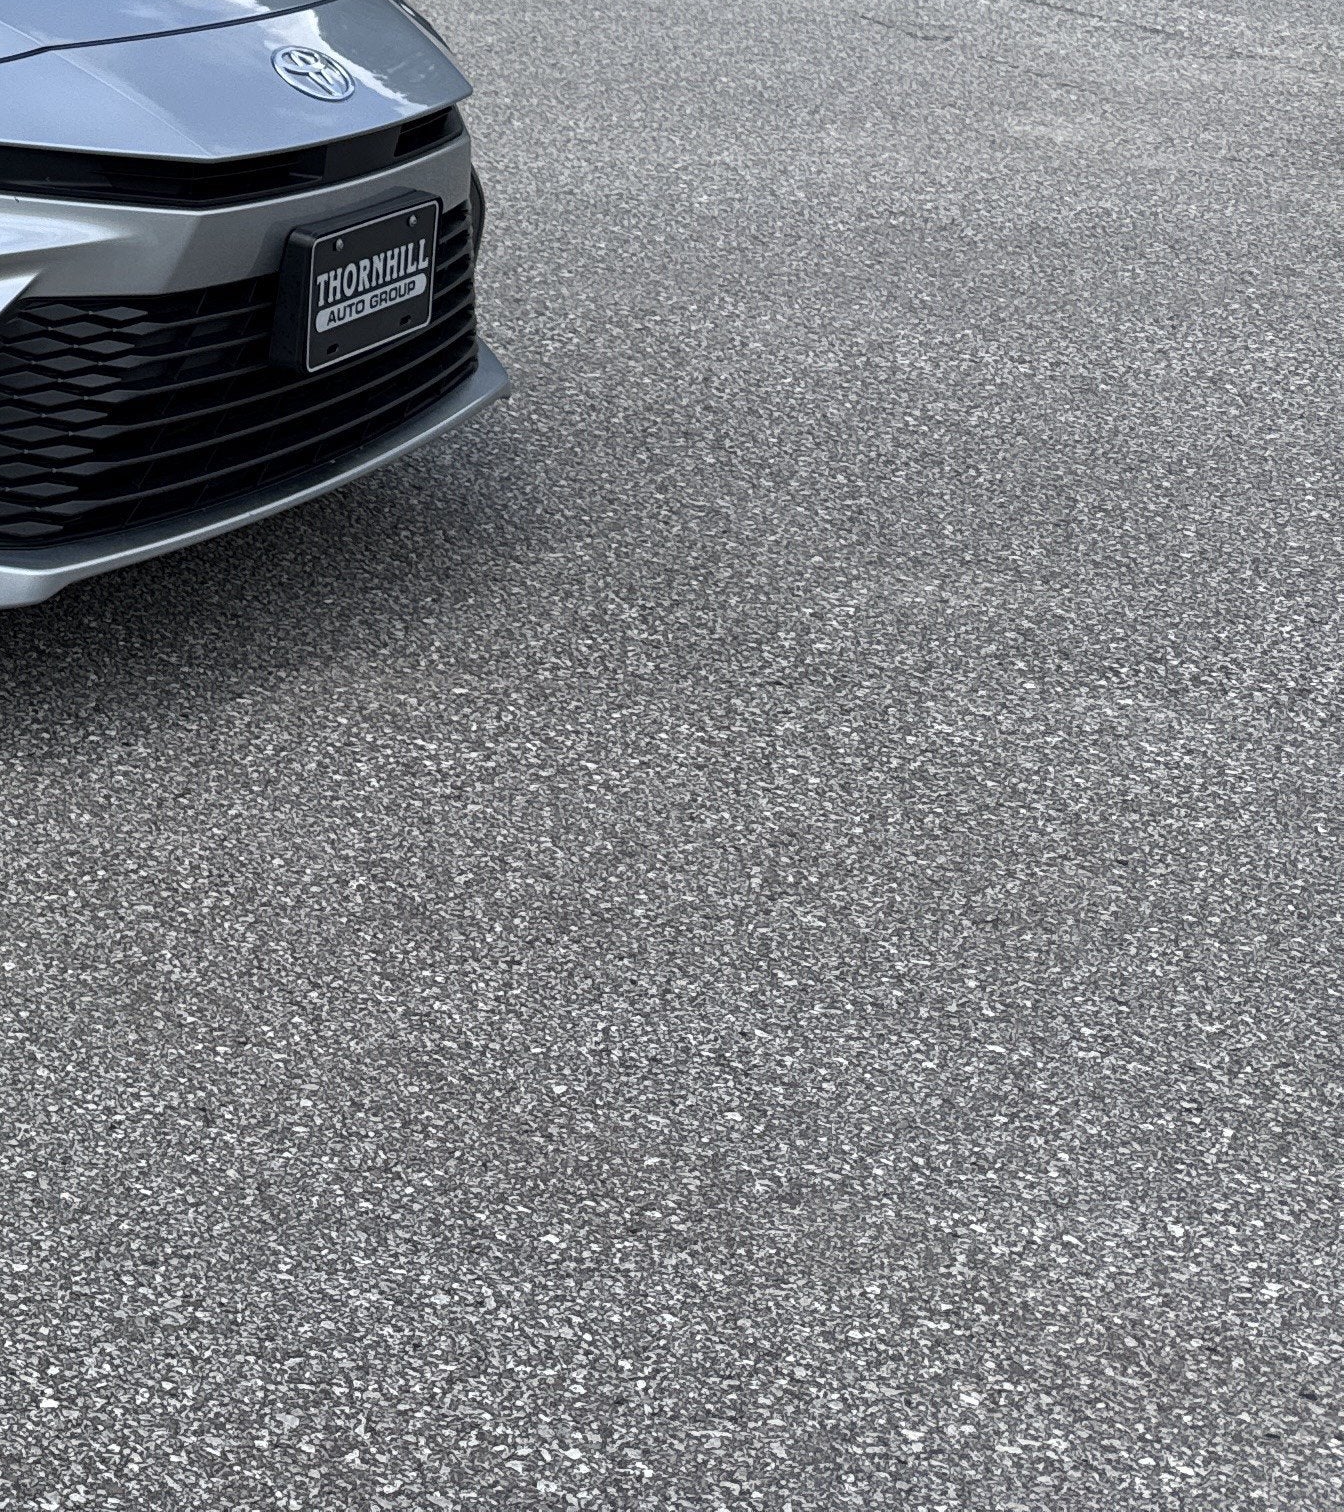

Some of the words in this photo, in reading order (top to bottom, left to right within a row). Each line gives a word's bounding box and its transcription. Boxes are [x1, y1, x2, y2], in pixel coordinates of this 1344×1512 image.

[316, 238, 429, 307] THORNHILL
[326, 298, 365, 326] AUTO
[369, 279, 416, 309] GROUP
